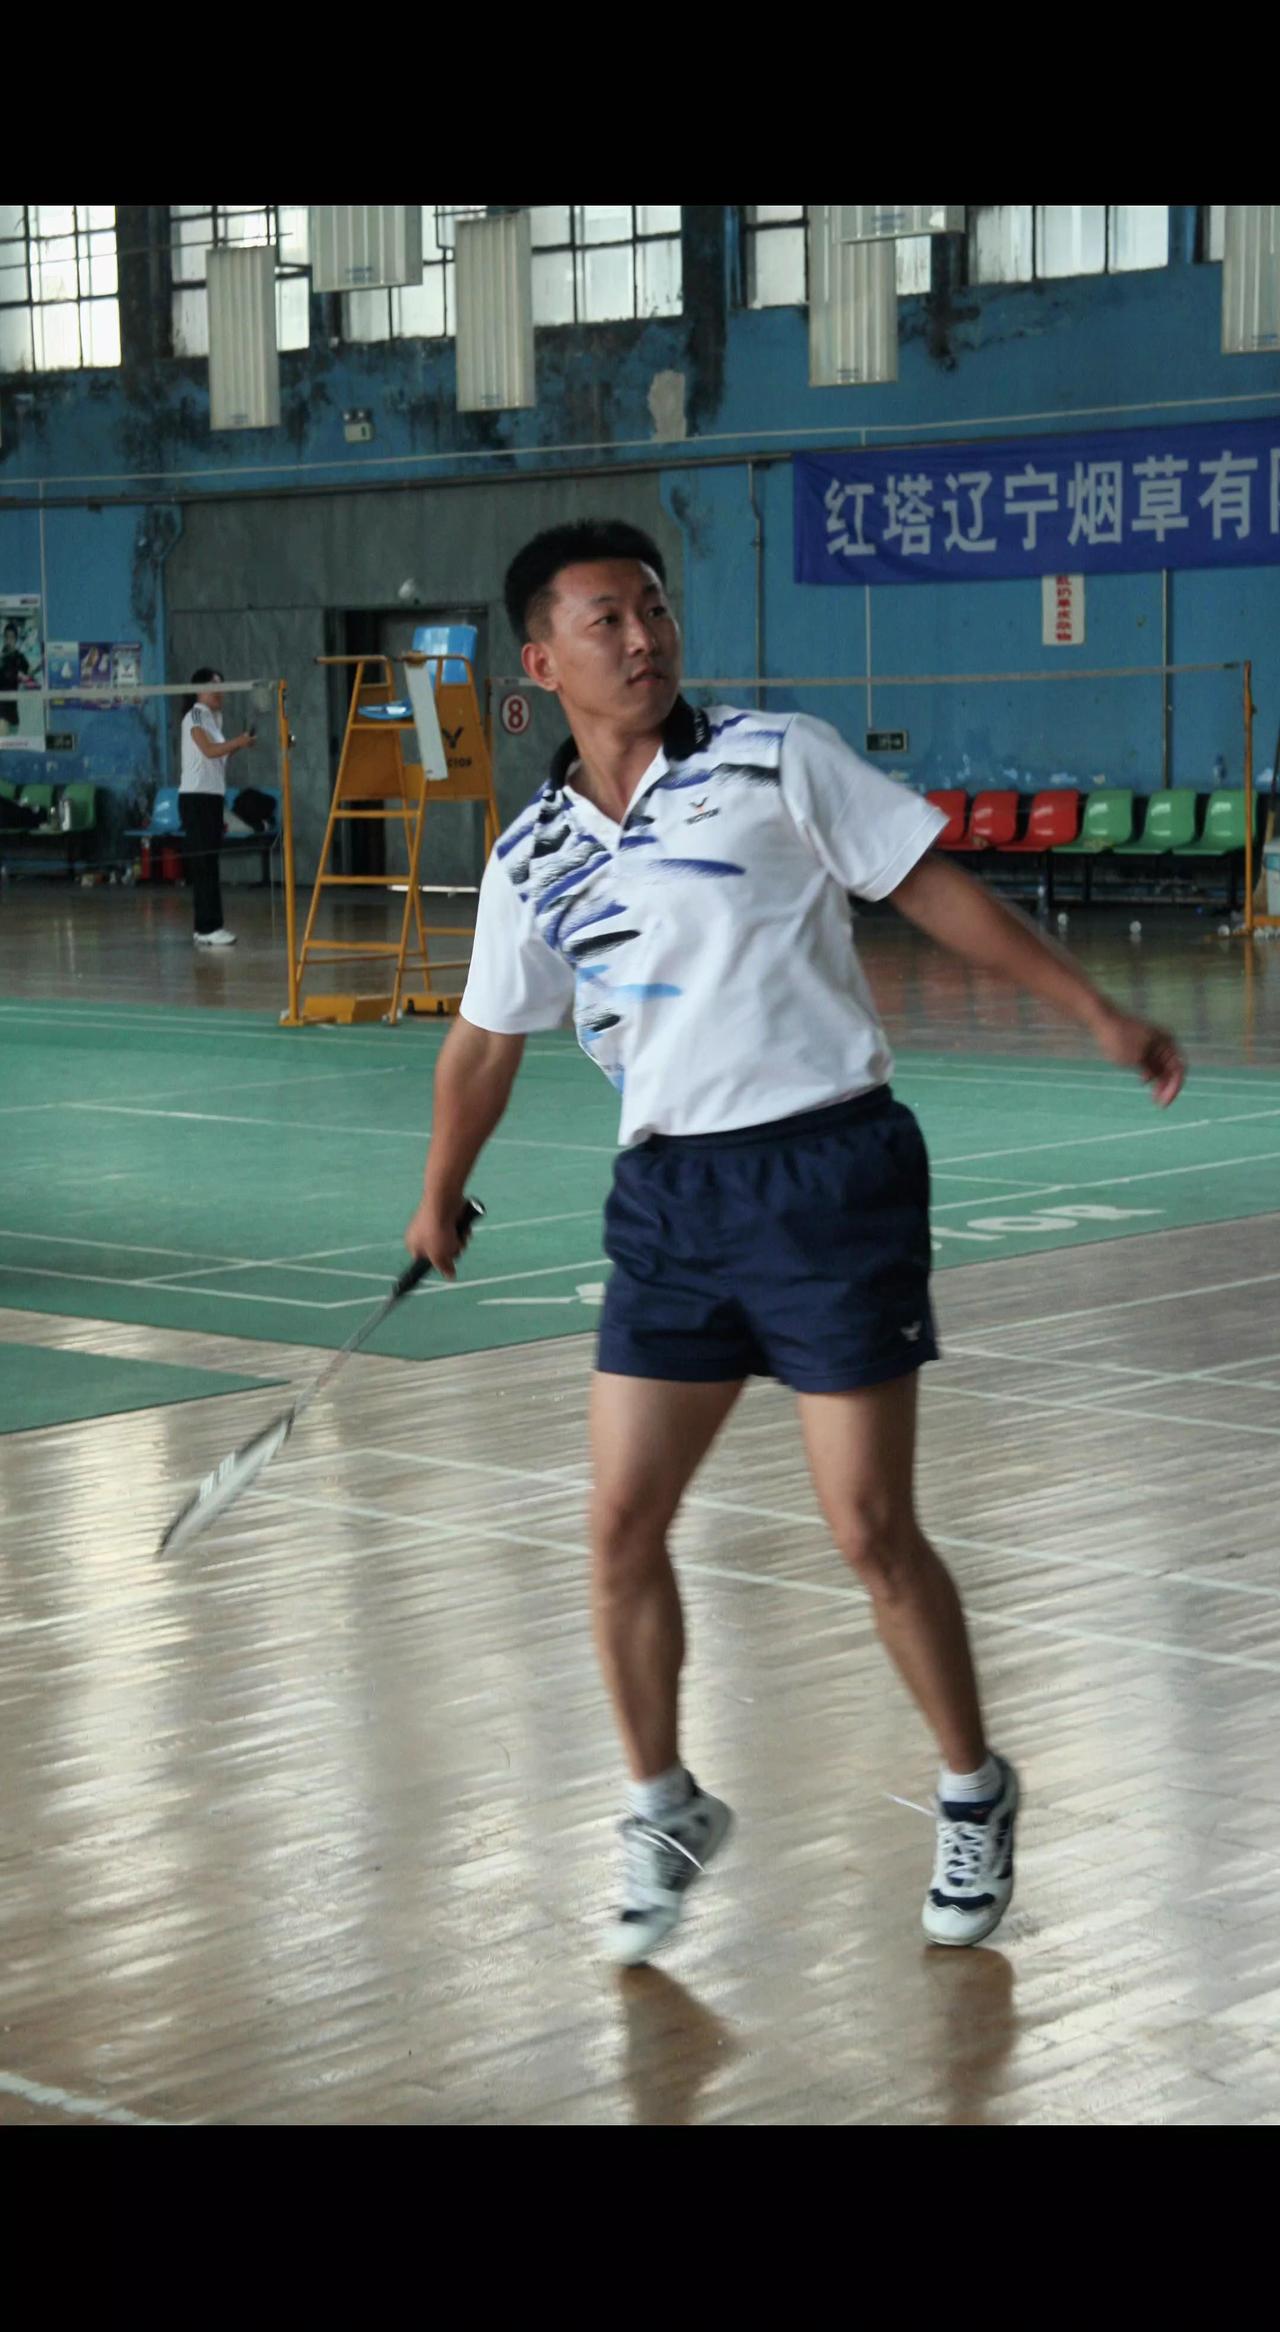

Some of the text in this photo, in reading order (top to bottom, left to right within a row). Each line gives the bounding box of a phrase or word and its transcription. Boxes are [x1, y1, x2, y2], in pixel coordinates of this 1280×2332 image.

[824, 447, 1280, 556] 红塔辽宁烟草有
[507, 697, 523, 730] 8
